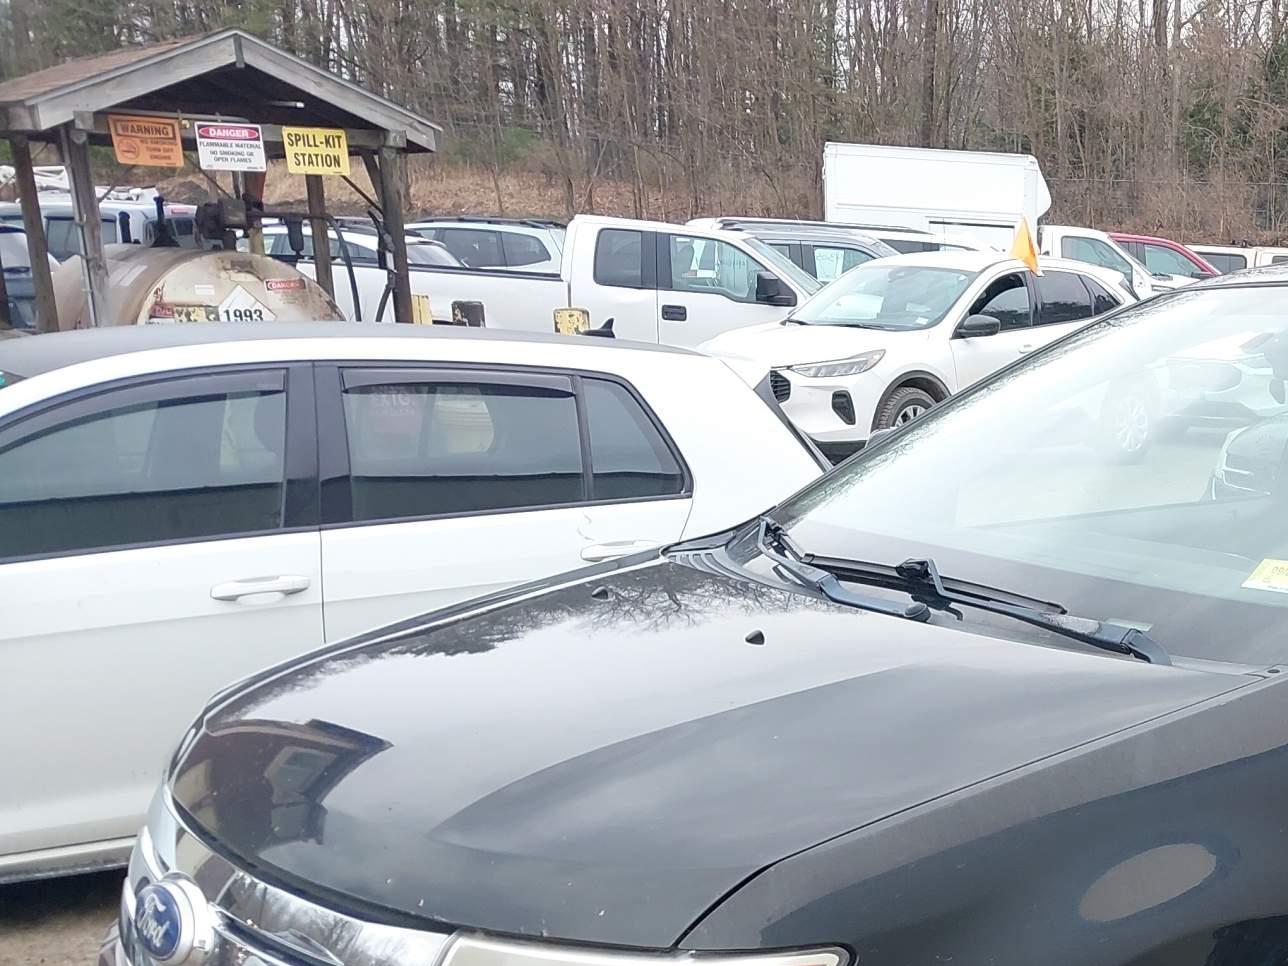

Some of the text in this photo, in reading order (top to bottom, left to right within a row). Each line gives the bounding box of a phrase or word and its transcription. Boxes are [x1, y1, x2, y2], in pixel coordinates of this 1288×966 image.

[120, 123, 169, 136] WARNING
[208, 127, 249, 137] DANGER
[287, 132, 342, 149] SPILL-KIT
[294, 152, 341, 168] STATION
[224, 308, 264, 321] 1993
